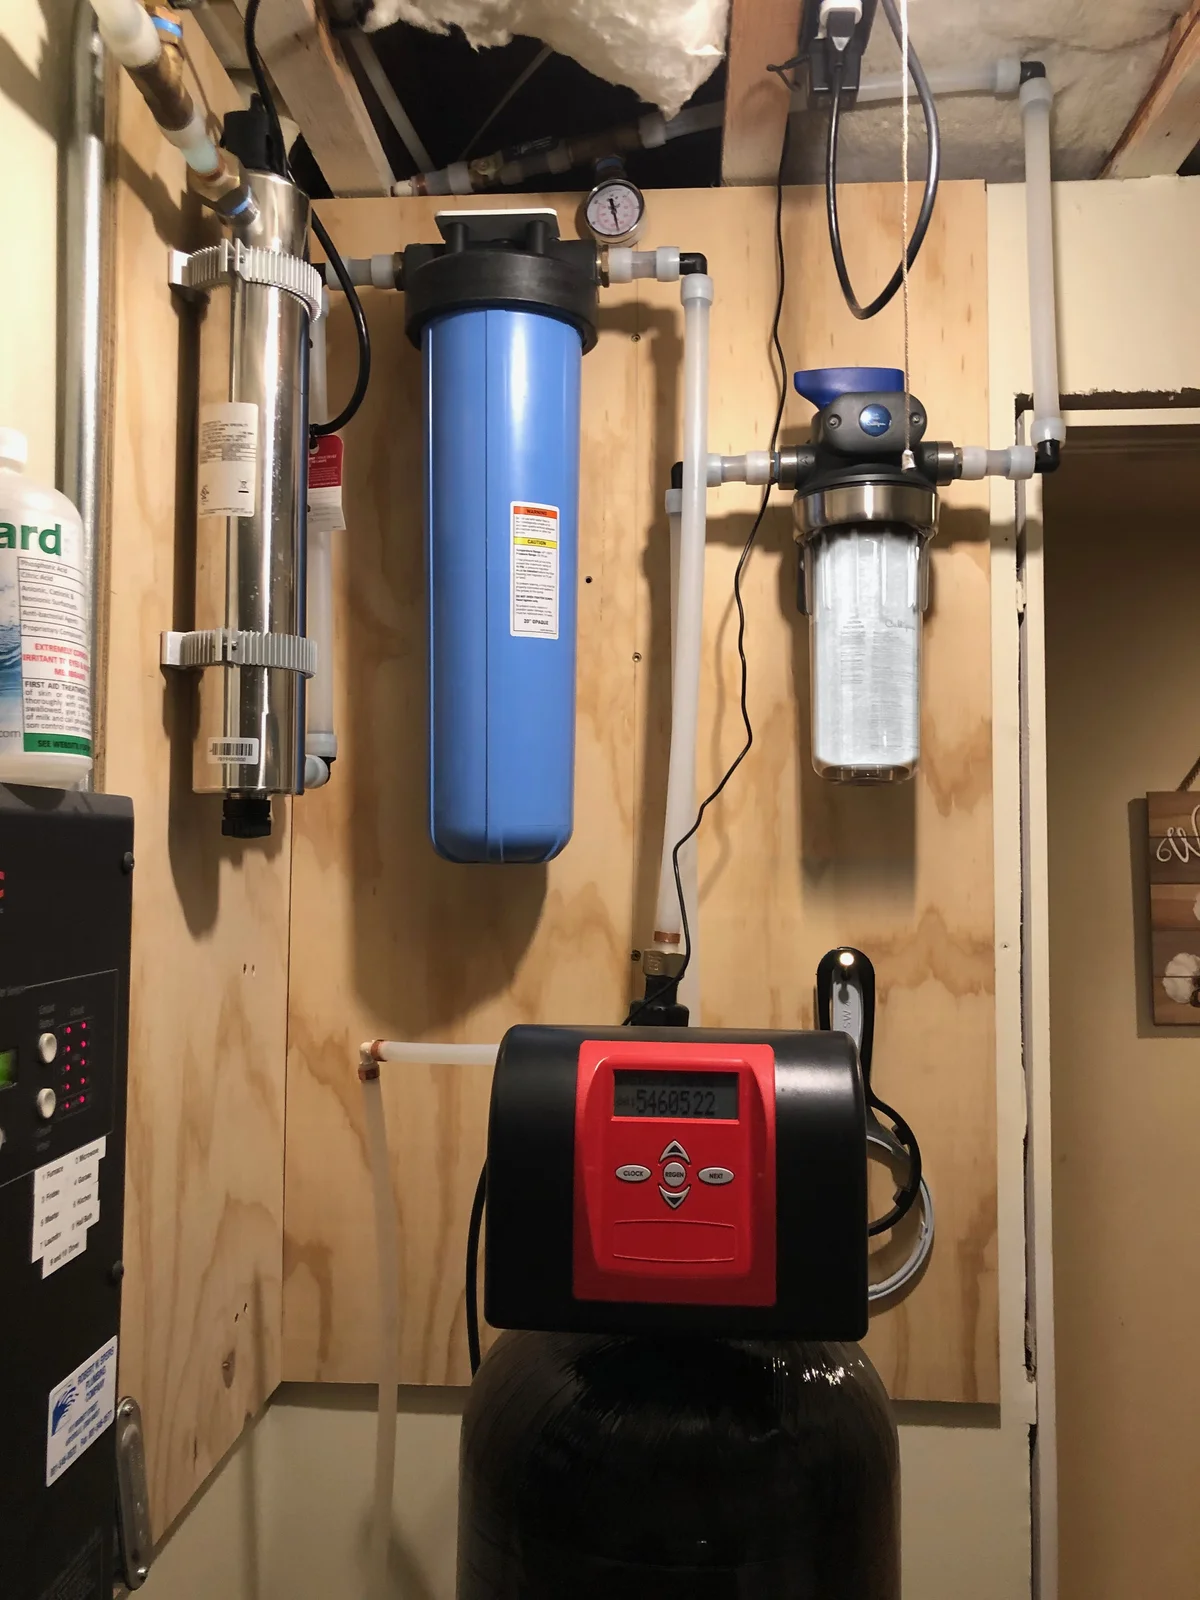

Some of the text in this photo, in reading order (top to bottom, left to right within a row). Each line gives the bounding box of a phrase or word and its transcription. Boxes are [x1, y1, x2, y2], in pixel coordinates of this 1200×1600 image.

[0, 522, 61, 556] ard
[23, 654, 58, 664] IRRITANT
[48, 682, 59, 690] AID
[636, 1089, 715, 1116] 5460522
